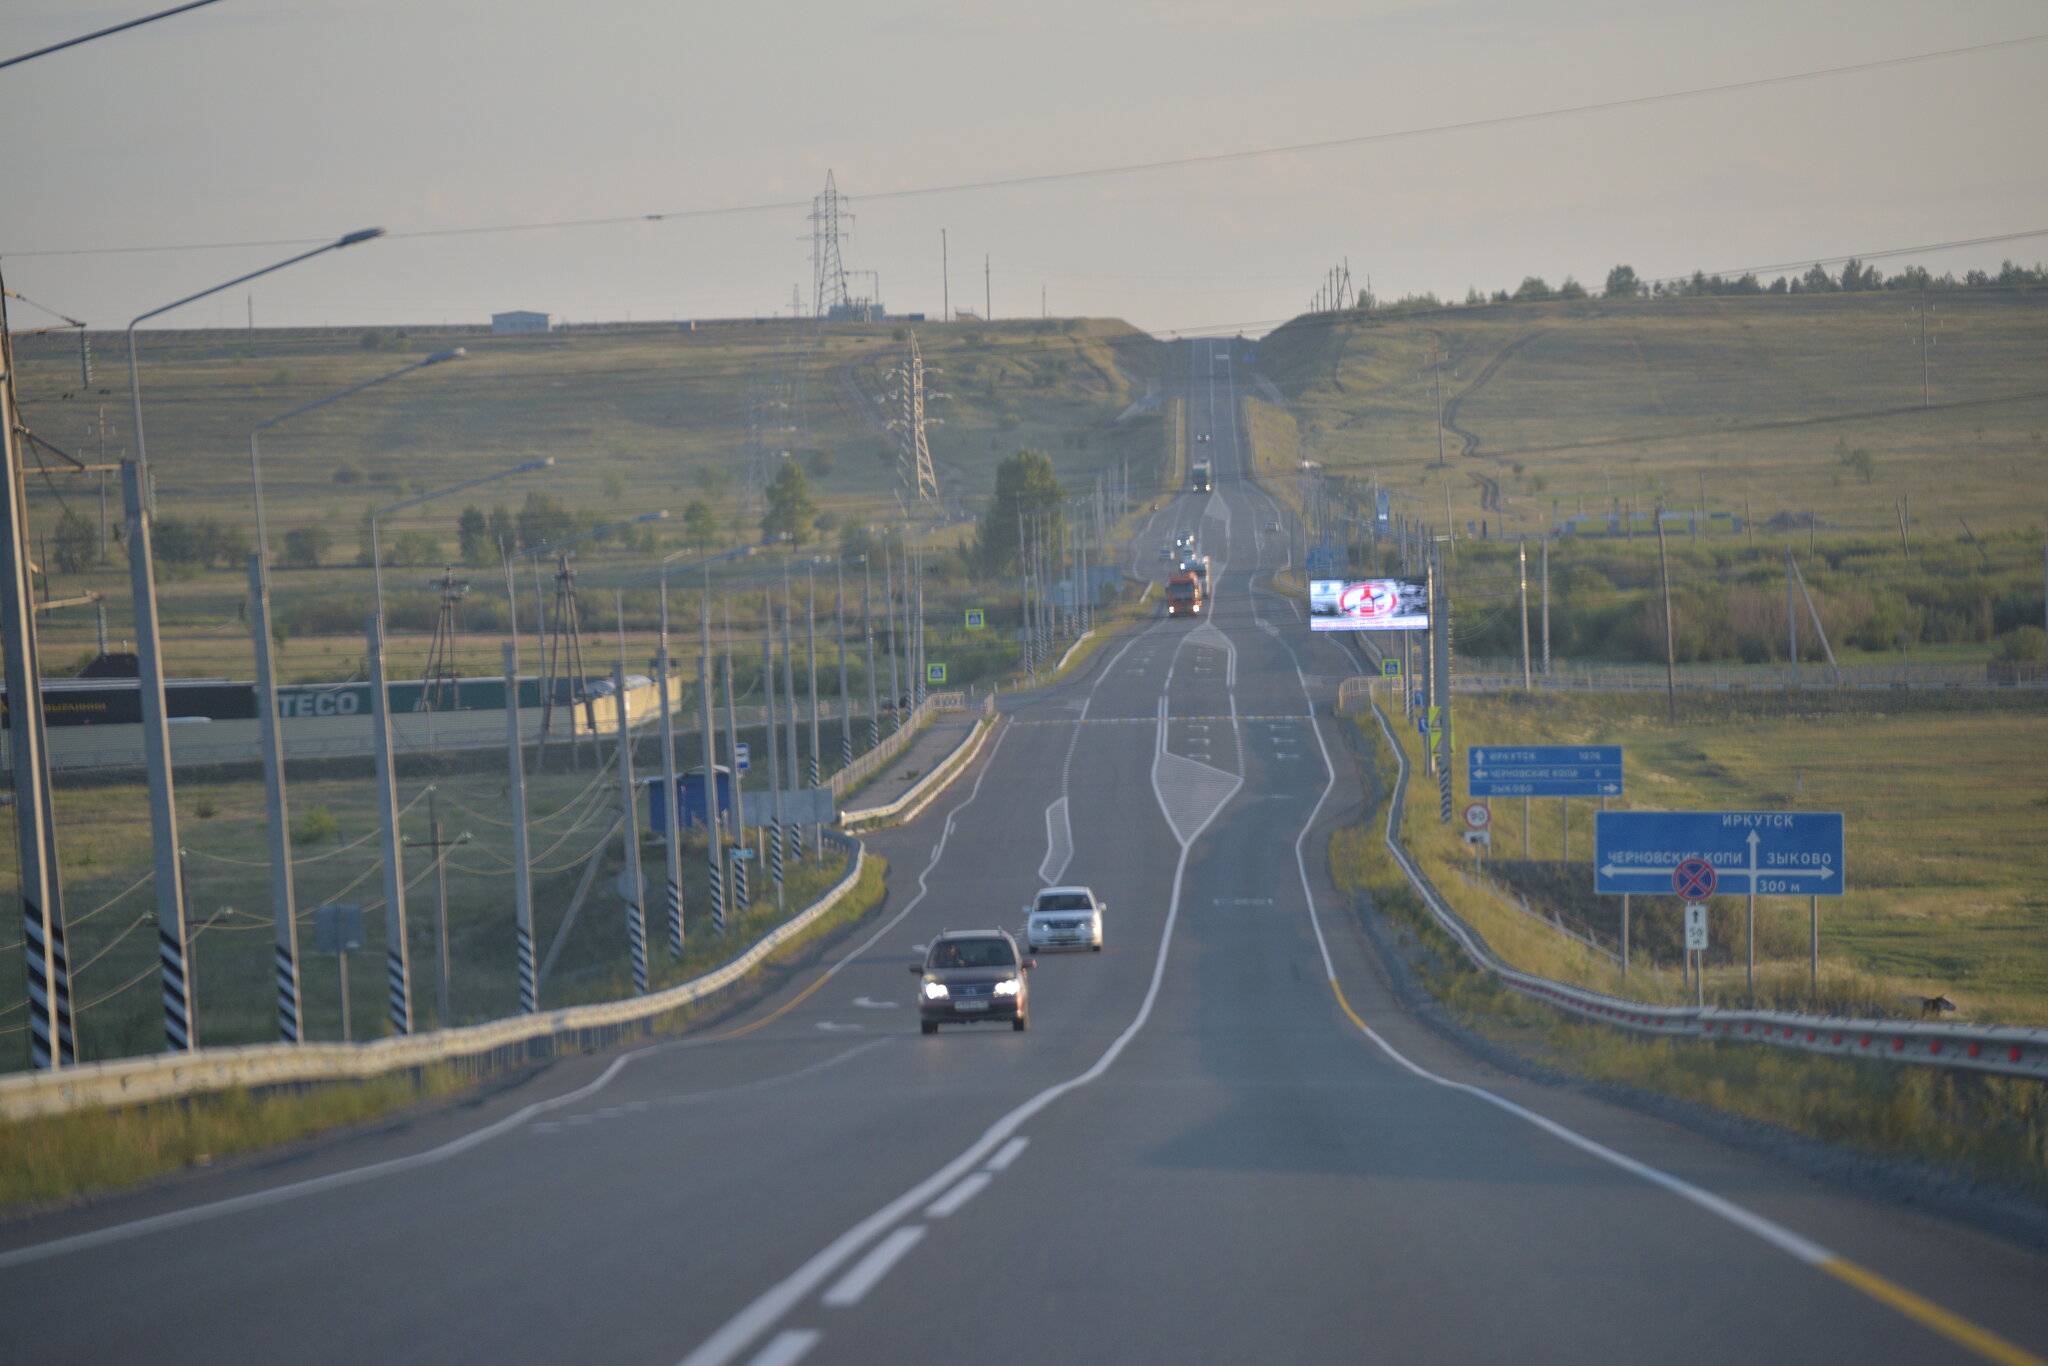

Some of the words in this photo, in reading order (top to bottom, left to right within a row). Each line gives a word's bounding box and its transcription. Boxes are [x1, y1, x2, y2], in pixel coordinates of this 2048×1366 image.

[1489, 751, 1536, 760] ИРКУТСК
[1490, 769, 1549, 777] ЧЕРНОВСКИЕ
[1552, 769, 1579, 777] КОПИ
[1490, 784, 1533, 792] ЗЫКОВО
[1470, 810, 1485, 822] 90
[1722, 815, 1793, 827] ИРКУТСК
[1607, 852, 1699, 864] ЧЕРНОВСКИЕ
[1703, 852, 1743, 864] КОПИ
[1766, 852, 1832, 864] ЗЫКОВО
[1760, 880, 1786, 892] 300
